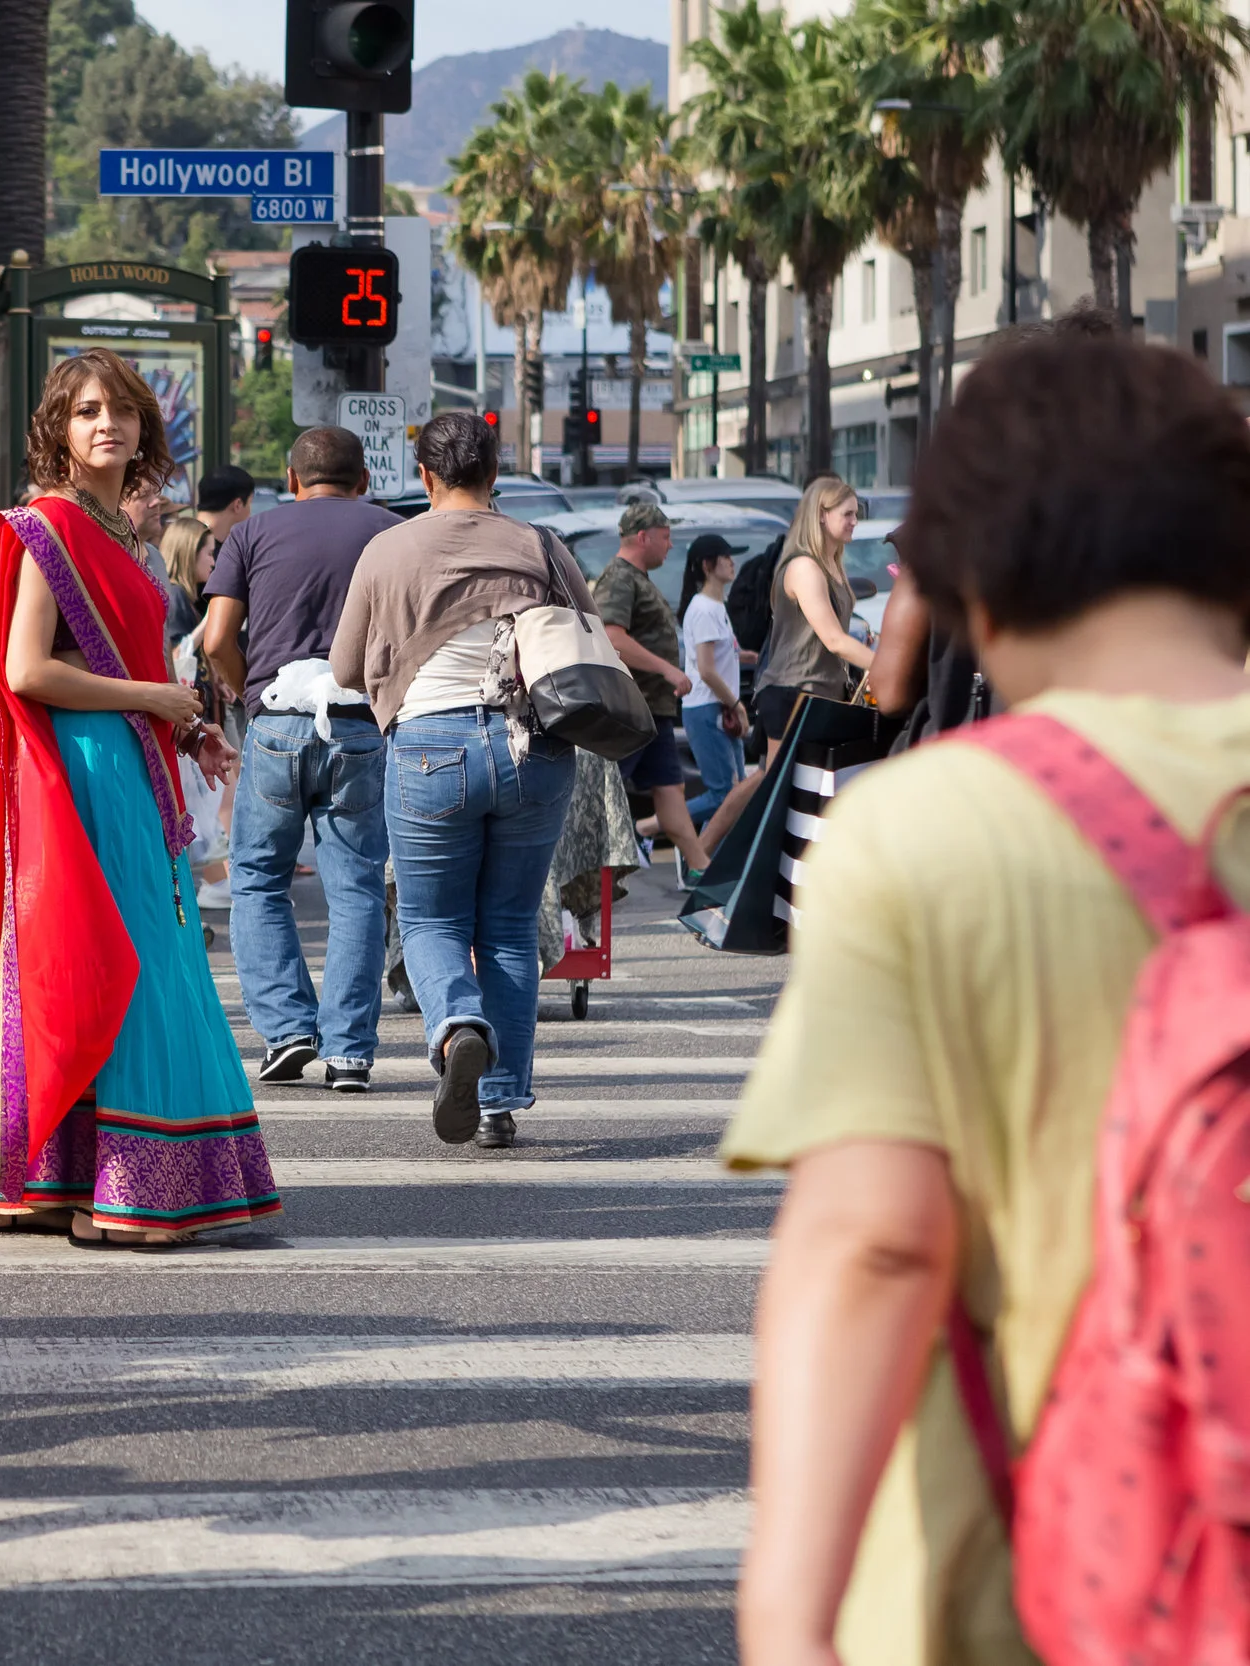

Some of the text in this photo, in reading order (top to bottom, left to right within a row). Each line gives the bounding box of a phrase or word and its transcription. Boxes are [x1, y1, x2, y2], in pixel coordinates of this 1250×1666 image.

[120, 157, 312, 193] Hollywood Bl
[256, 200, 327, 219] 6800 W
[70, 265, 169, 284] HOLLYWOOD
[342, 268, 387, 326] 25
[349, 400, 396, 416] CROSS
[365, 420, 380, 432] ON
